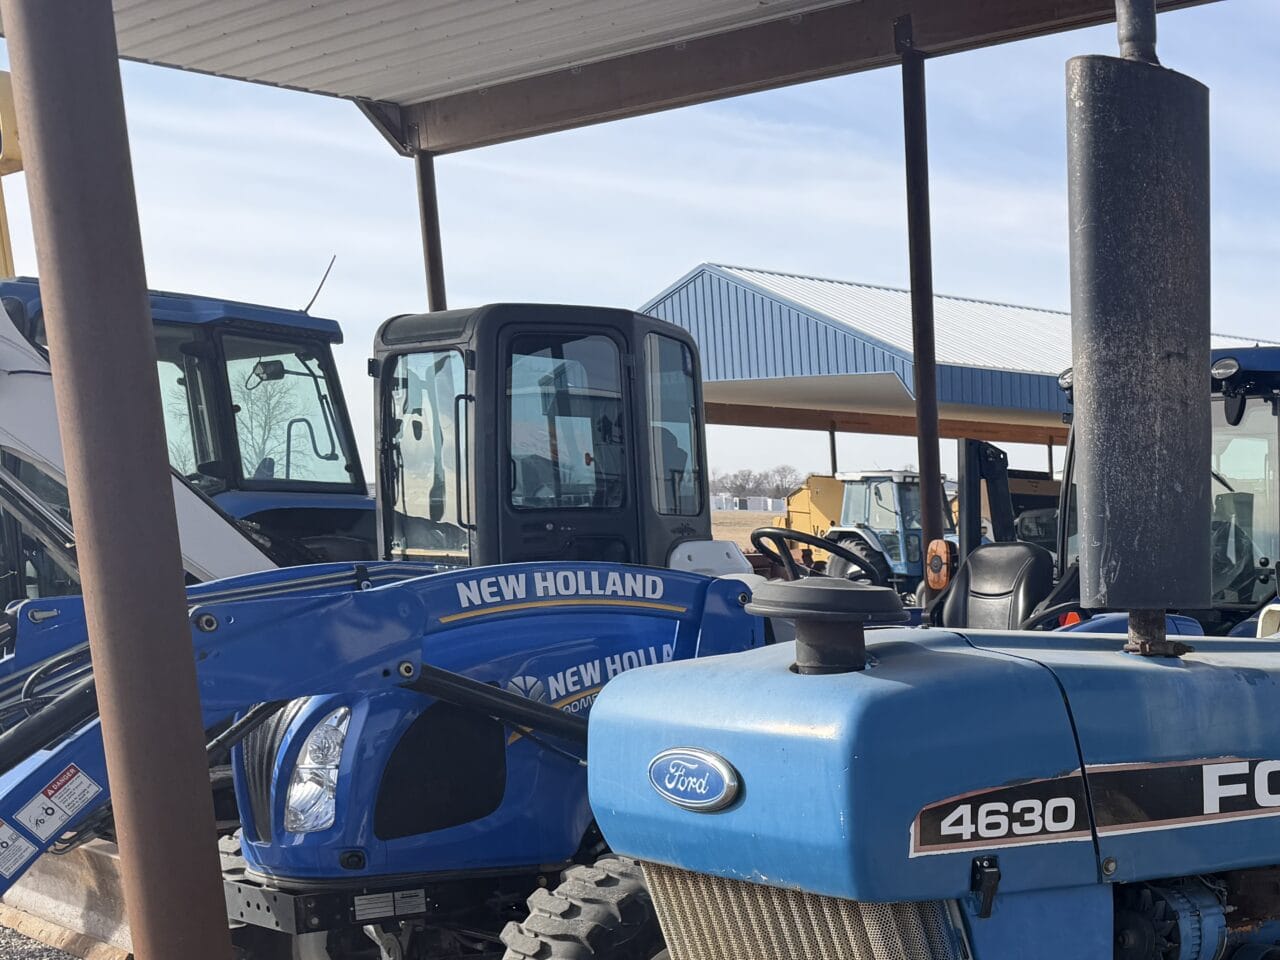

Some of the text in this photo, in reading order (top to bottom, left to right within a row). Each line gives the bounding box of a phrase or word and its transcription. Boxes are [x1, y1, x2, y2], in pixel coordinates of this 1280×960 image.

[456, 570, 664, 608] NEW HOLLAND
[548, 643, 674, 700] NEW HOLLA
[664, 760, 709, 794] Ford
[940, 797, 1076, 840] 4630
